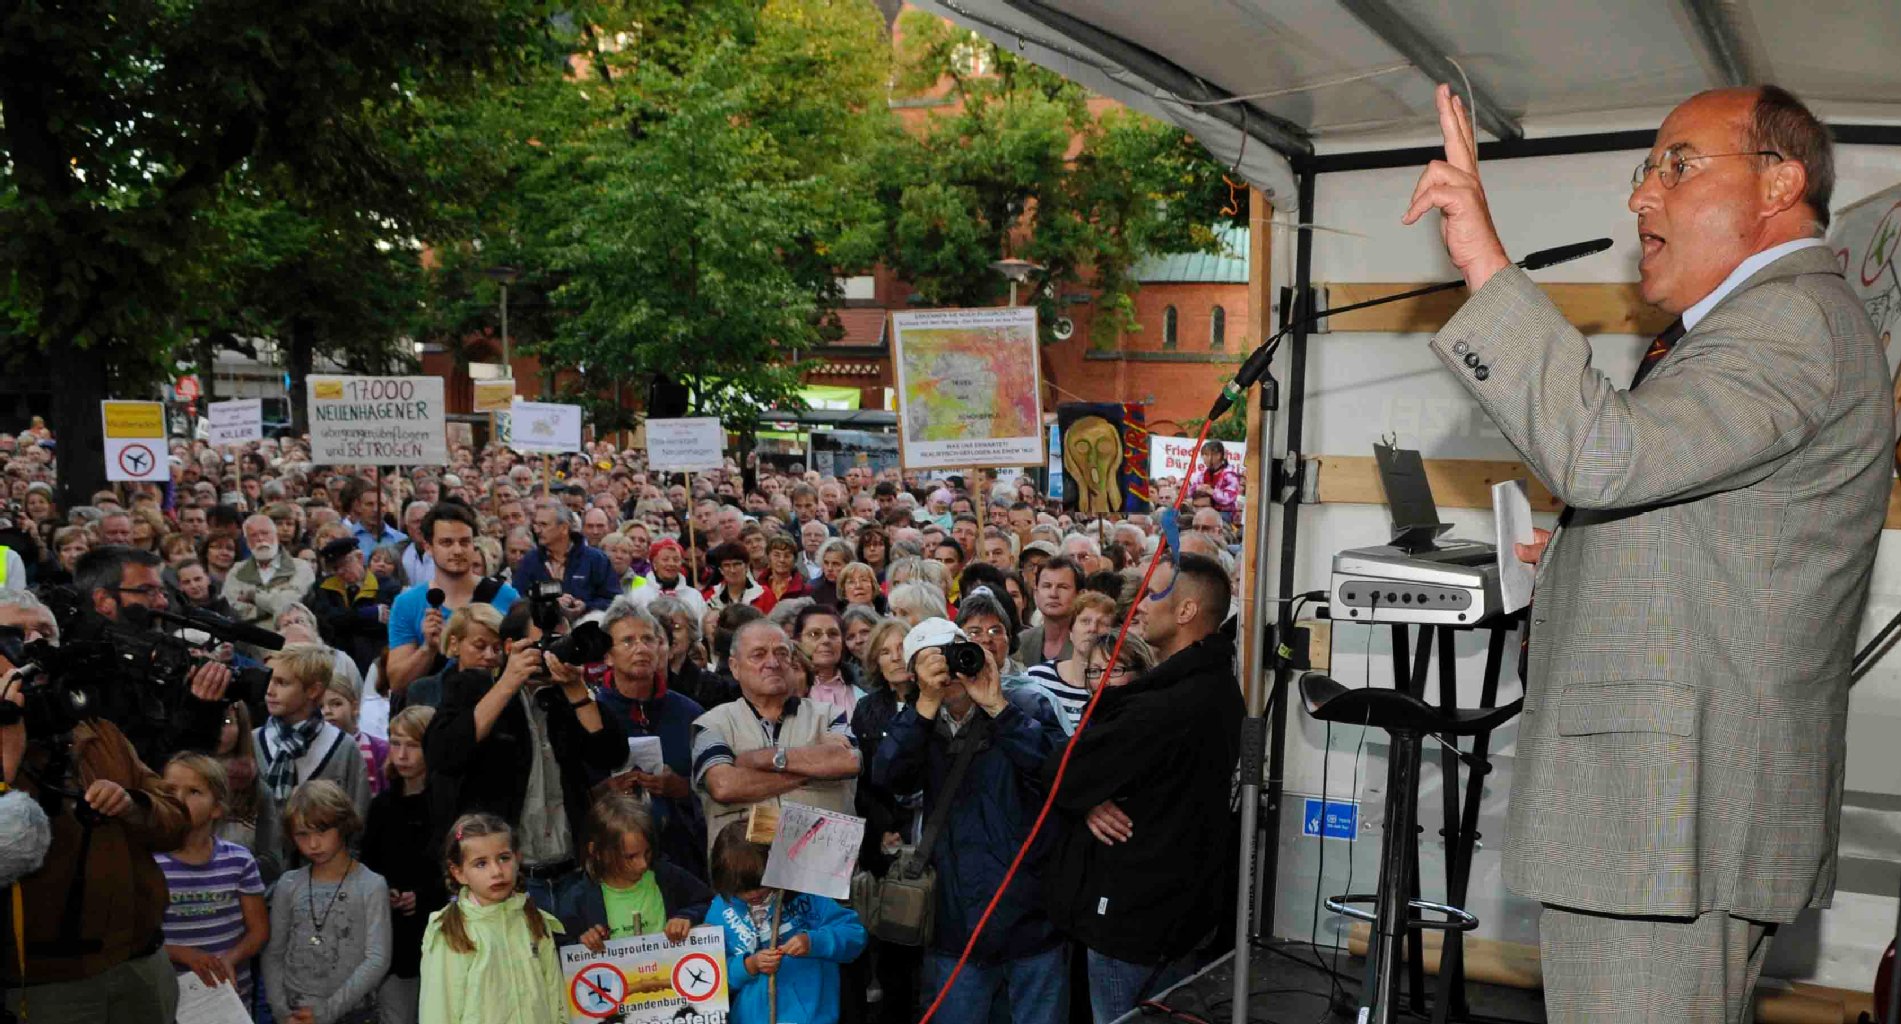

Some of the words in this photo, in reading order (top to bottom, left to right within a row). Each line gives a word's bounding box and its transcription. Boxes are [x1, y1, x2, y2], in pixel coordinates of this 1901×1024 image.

[315, 401, 430, 421] NEUENHAGENER
[325, 442, 345, 458] und
[347, 441, 423, 458] BETROGEN
[567, 950, 598, 963] Keine
[601, 941, 660, 961] Flugrouten
[690, 934, 720, 946] Berlin
[638, 962, 658, 974] und
[618, 996, 687, 1014] Brandenburg
